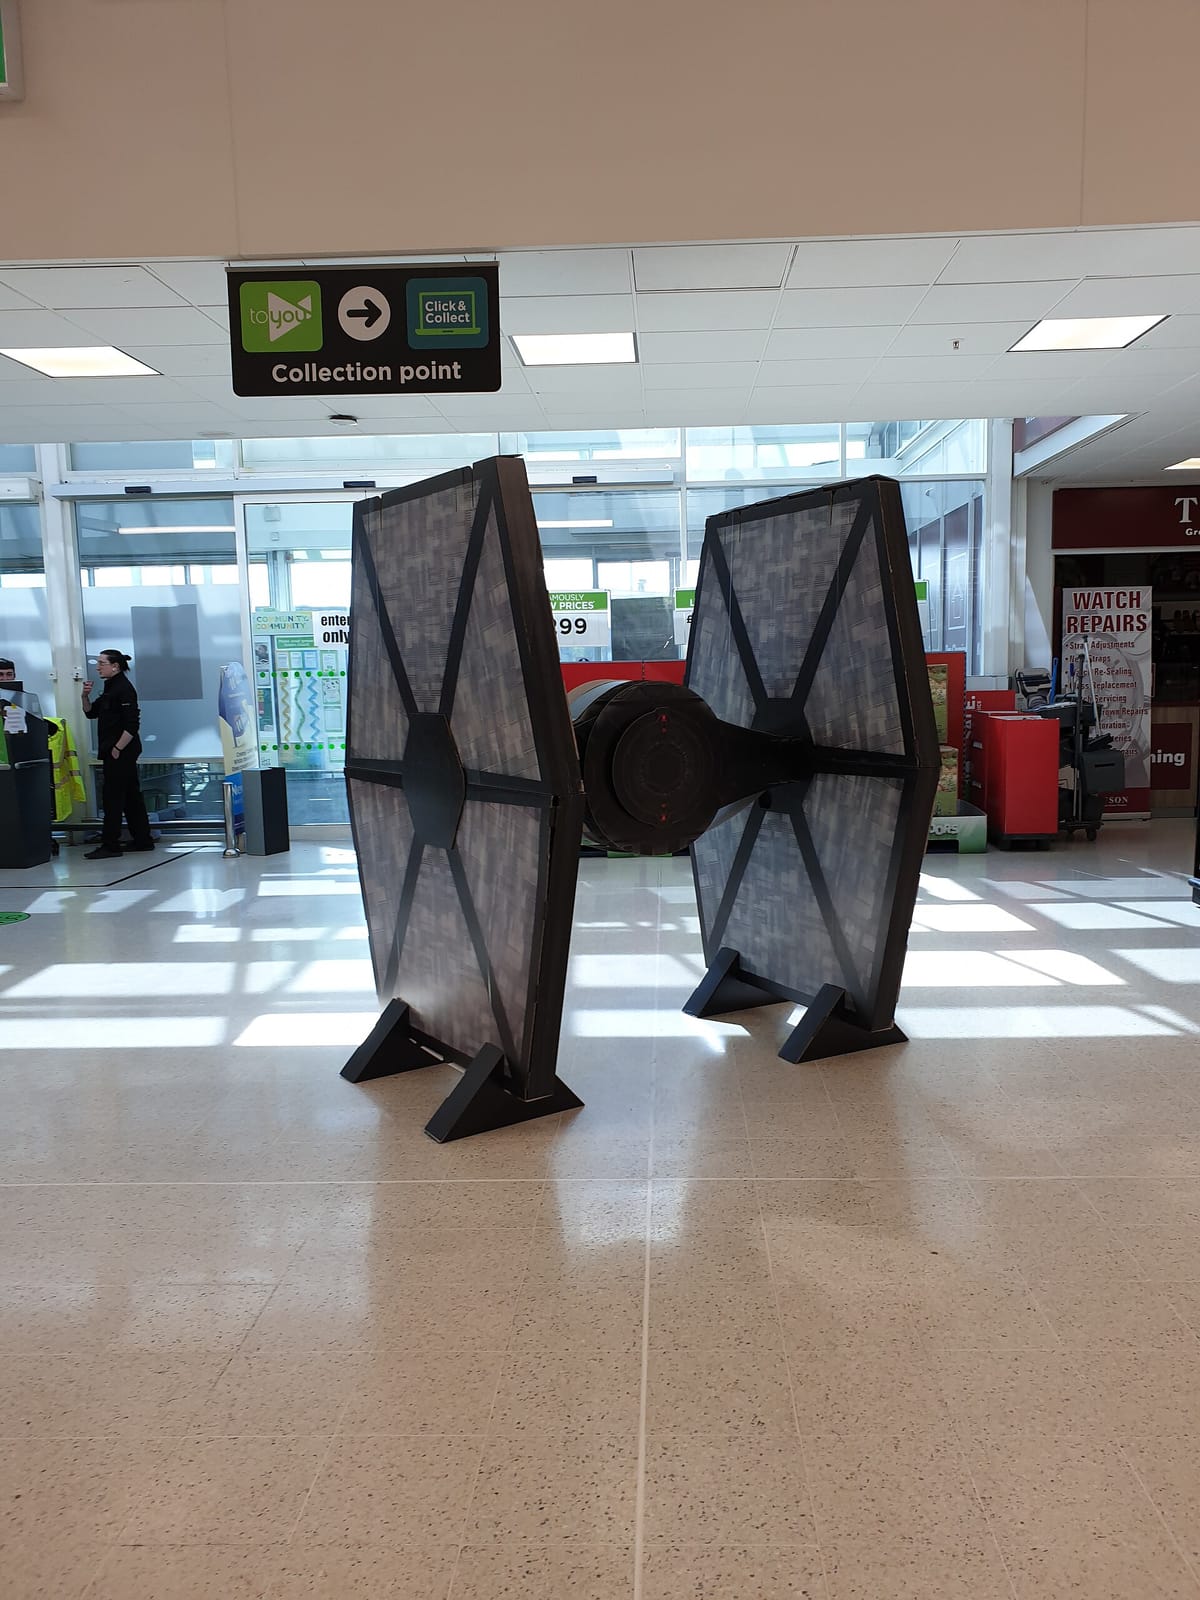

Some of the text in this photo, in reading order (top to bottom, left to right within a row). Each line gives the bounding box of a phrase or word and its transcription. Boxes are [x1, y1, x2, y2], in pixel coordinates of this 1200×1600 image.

[425, 300, 467, 312] Click &
[425, 311, 471, 323] Collect
[271, 361, 462, 384] Collection point
[559, 601, 594, 610] PRICES
[1073, 591, 1141, 610] WATCH
[553, 618, 587, 635] 99
[1066, 613, 1147, 634] REPAIRS
[1090, 640, 1135, 650] Adjustments
[1094, 667, 1133, 677] Re-Sealing
[1094, 694, 1127, 704] Servicing
[1120, 707, 1148, 717] Repairs
[1151, 749, 1185, 767] ning
